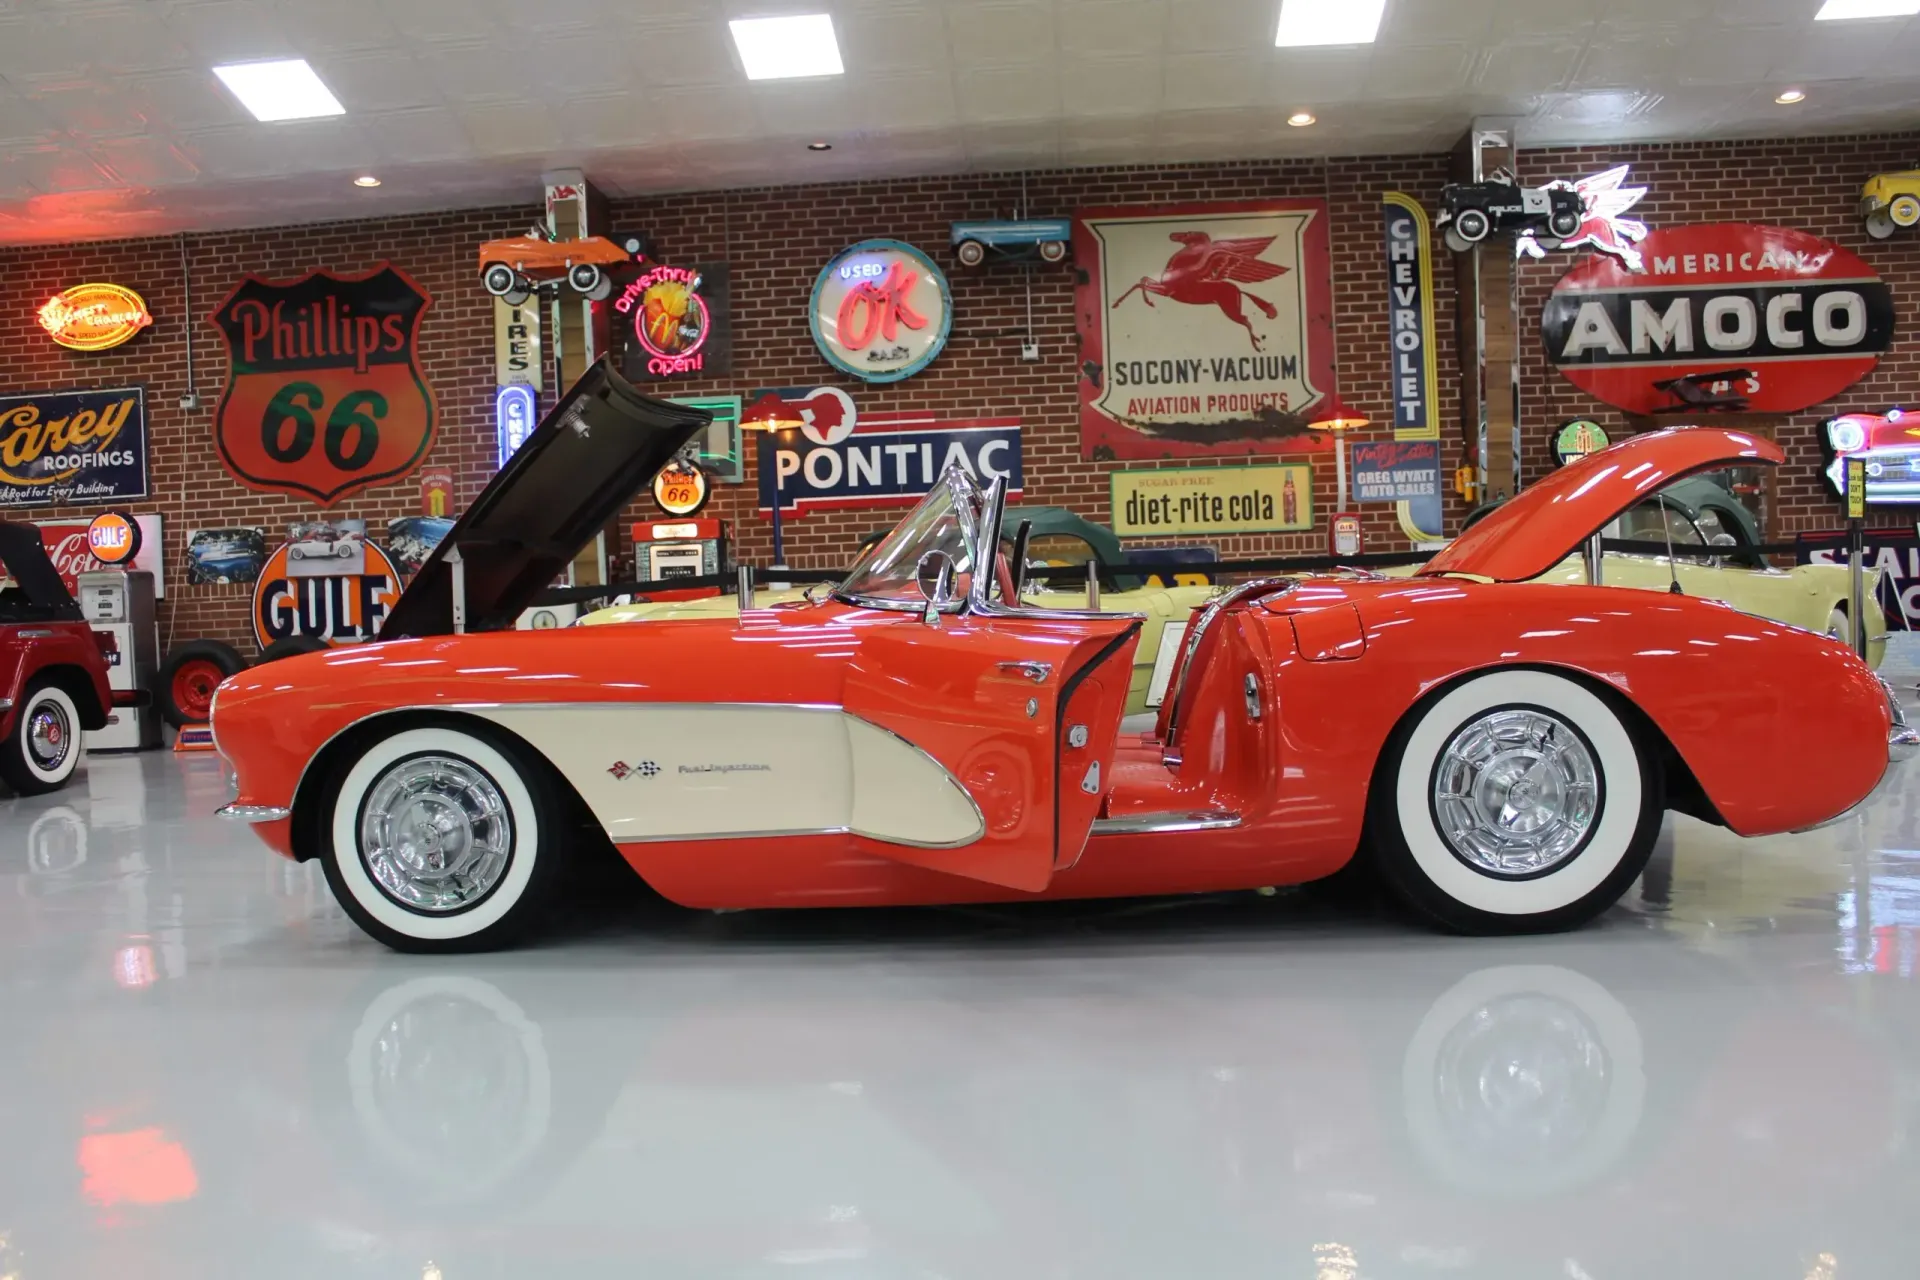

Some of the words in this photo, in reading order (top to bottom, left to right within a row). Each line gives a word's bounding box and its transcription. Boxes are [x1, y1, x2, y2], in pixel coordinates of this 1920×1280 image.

[1488, 205, 1523, 213] POLICE
[840, 263, 884, 280] USED
[614, 264, 698, 314] Drive-Thru
[836, 259, 928, 351] OK
[1390, 218, 1421, 421] CHEVROLET
[230, 295, 405, 373] Phillips
[508, 307, 529, 371] IRES
[1561, 289, 1868, 358] AMOCO
[647, 353, 703, 377] Open!
[1115, 355, 1297, 386] SOCONY-VACUUM
[1127, 396, 1200, 416] AVIATION
[1207, 393, 1289, 415] PRODUCTS
[0, 398, 136, 484] Carey
[260, 381, 389, 472] 66
[44, 450, 135, 471] ROOFINGS
[775, 439, 1011, 491] PONTIAC
[32, 486, 45, 498] for
[47, 485, 76, 499] Every
[1138, 477, 1179, 488] SUGAR
[1182, 476, 1216, 487] FREE
[1356, 471, 1391, 485] GREG
[1392, 469, 1436, 483] WYATT
[1361, 484, 1395, 498] AUTO
[1396, 483, 1435, 497] SALES
[668, 487, 690, 503] 66
[1126, 489, 1223, 526] diet-rite
[1229, 489, 1274, 521] cola
[91, 526, 127, 548] GULF
[261, 575, 392, 641] GULF
